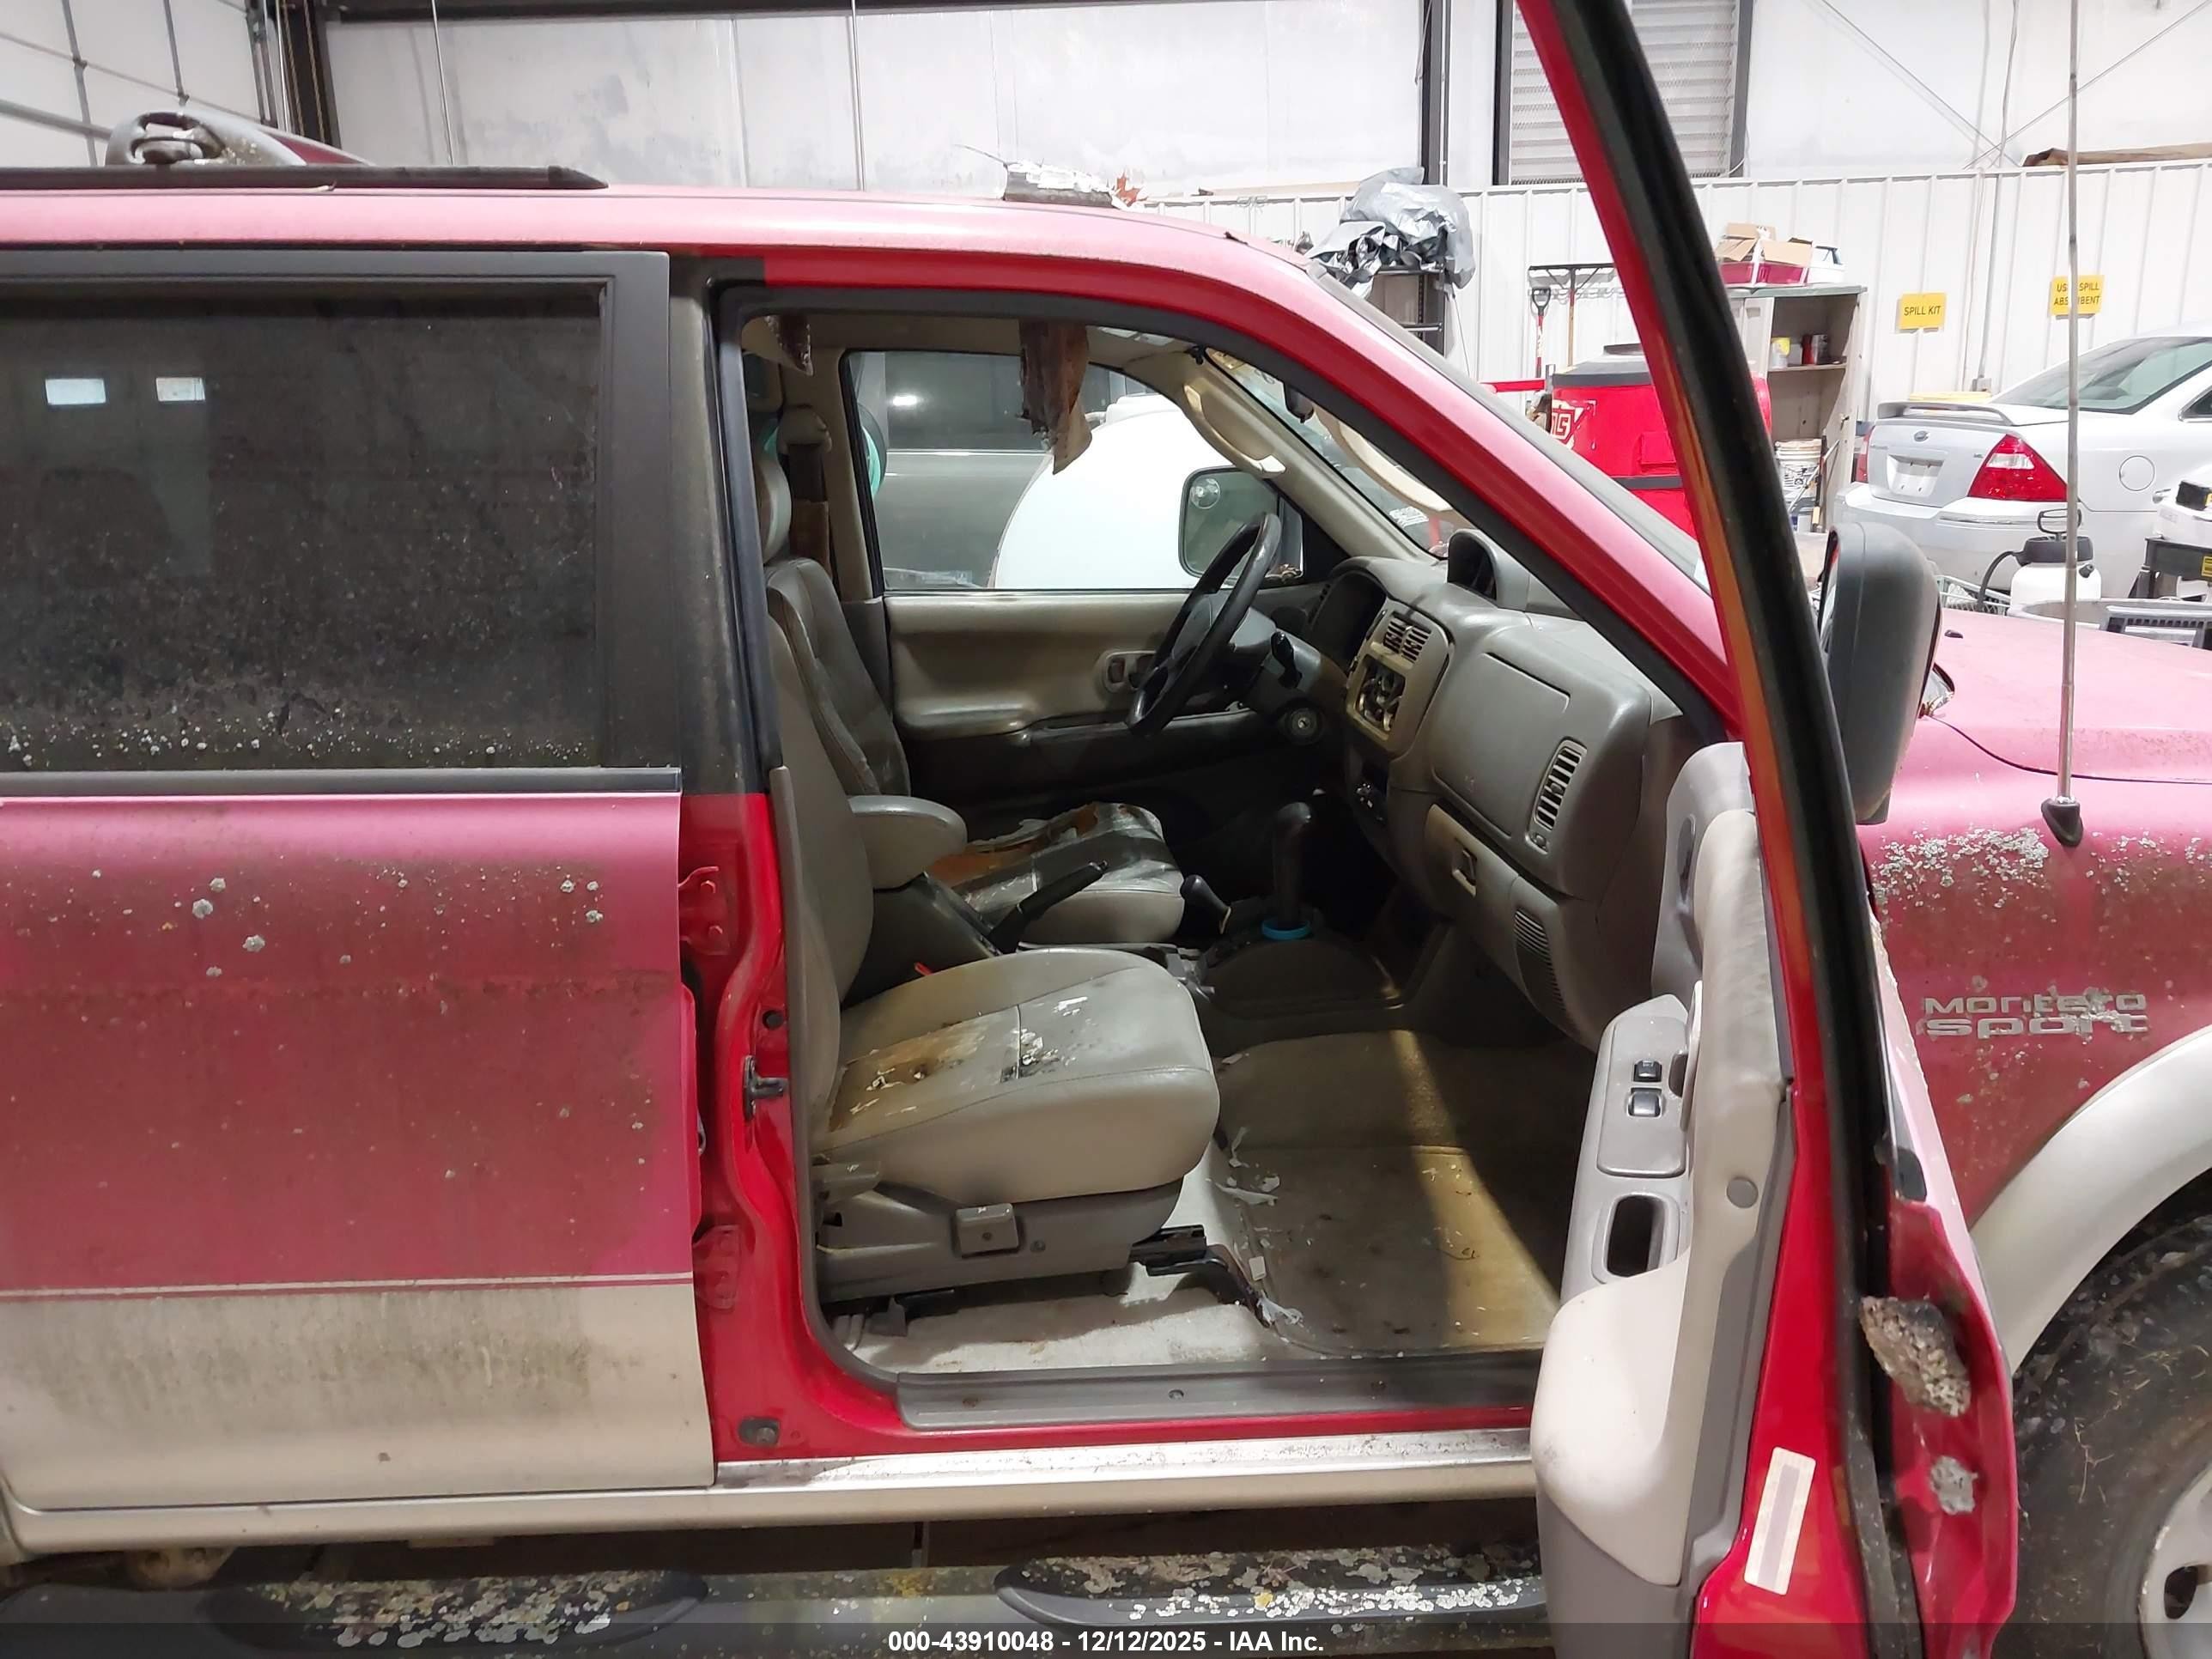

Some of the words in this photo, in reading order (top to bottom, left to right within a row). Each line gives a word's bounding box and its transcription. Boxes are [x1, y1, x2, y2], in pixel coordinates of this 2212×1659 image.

[2079, 282, 2100, 291] SPILL
[1903, 306, 1925, 316] SPILL
[1928, 305, 1942, 315] KIT
